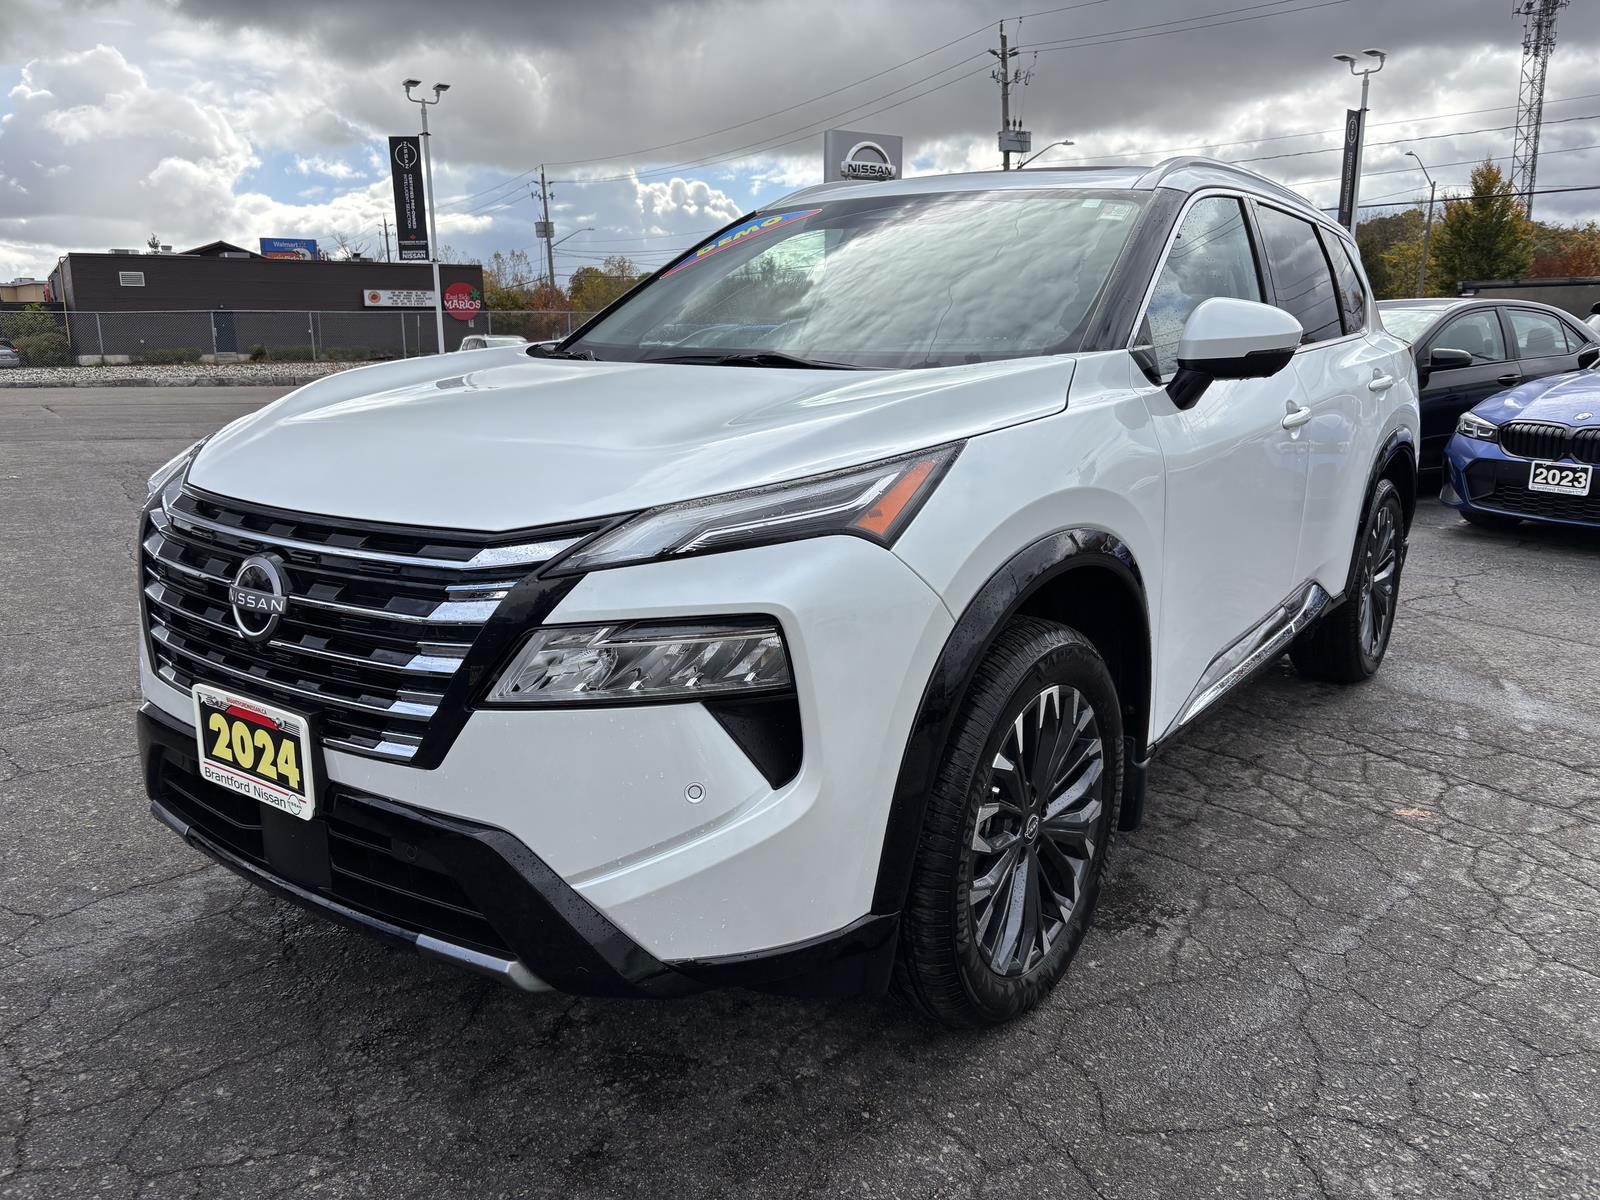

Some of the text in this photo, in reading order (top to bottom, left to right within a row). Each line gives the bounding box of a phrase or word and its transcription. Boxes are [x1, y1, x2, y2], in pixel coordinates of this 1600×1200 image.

[847, 163, 892, 176] NISSAN
[696, 216, 783, 256] DEMO
[1534, 468, 1587, 488] 2023
[229, 586, 284, 612] NISSAN
[209, 712, 300, 790] 2024
[204, 766, 287, 808] Brantford Nissan
